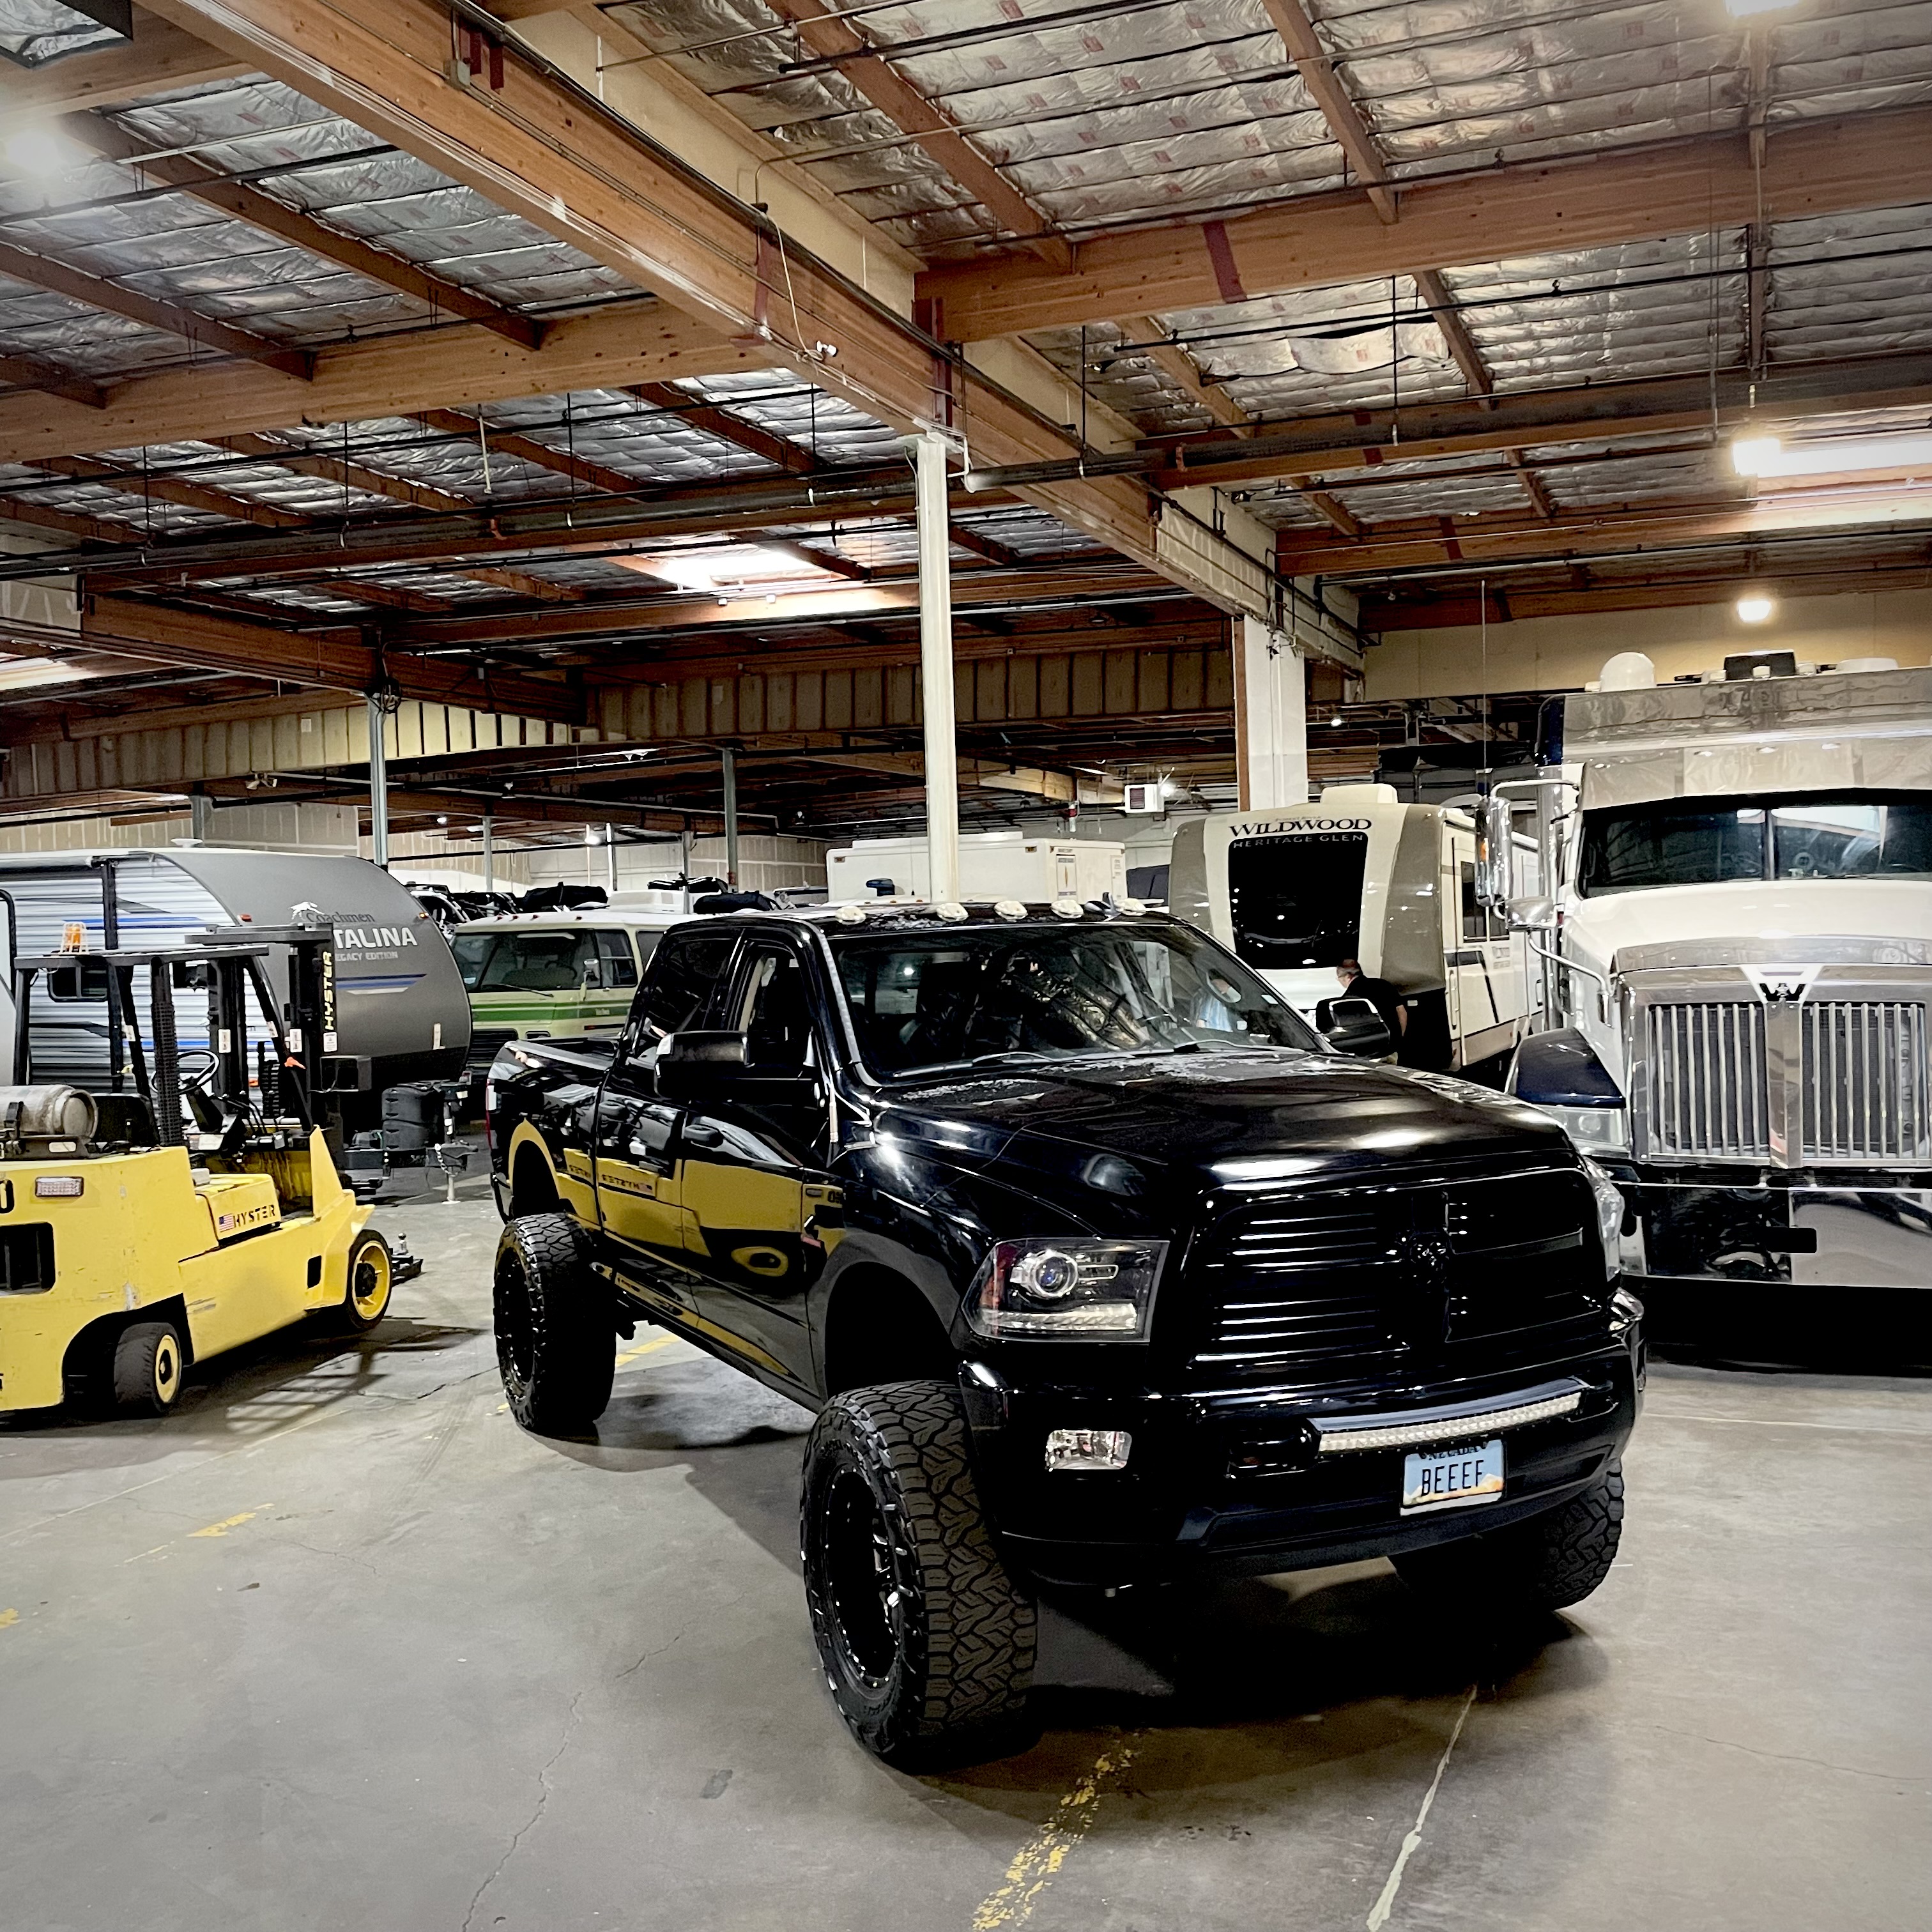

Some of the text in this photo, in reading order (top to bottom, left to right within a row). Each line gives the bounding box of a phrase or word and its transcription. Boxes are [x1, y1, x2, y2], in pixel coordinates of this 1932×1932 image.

[1229, 818, 1372, 837] WILDWOOD
[1233, 836, 1313, 848] HERITAGE
[306, 912, 375, 923] Coachmen
[333, 927, 418, 949] TALINA
[335, 953, 362, 962] EGACY
[323, 951, 334, 1031] HYSTER
[233, 1204, 275, 1228] HYSTER
[1421, 1459, 1484, 1497] BEEEF
